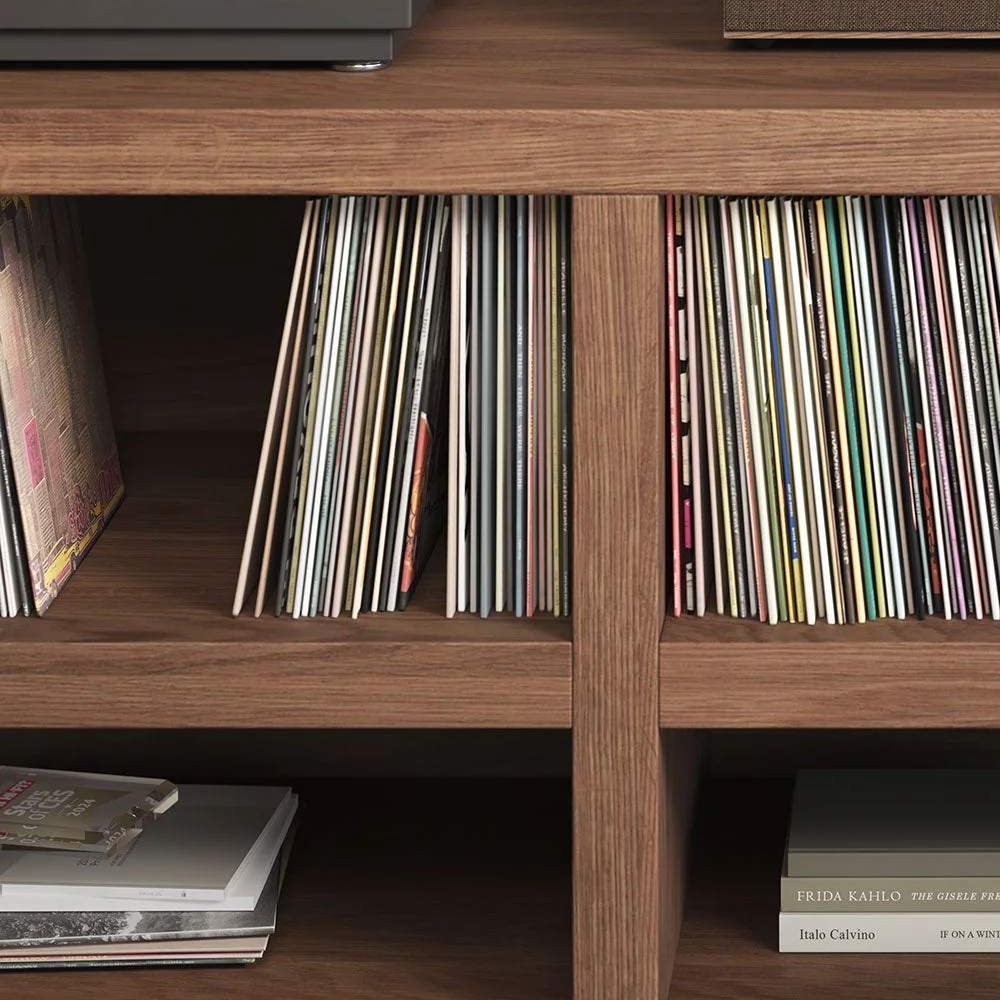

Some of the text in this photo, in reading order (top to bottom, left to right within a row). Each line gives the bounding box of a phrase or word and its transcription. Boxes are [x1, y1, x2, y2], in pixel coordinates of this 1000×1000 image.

[958, 257, 998, 531] JEANELLE MONAGAN THE ARCHENEMY
[4, 789, 50, 817] Stars
[38, 789, 76, 809] CES
[67, 798, 97, 817] 2024
[797, 891, 901, 902] FRIDA KAHLO
[911, 892, 933, 901] THE
[937, 892, 977, 901] GISELE
[799, 928, 876, 940] Italo Calvino
[940, 930, 949, 939] IF
[951, 930, 966, 939] ON
[967, 930, 975, 939] A
